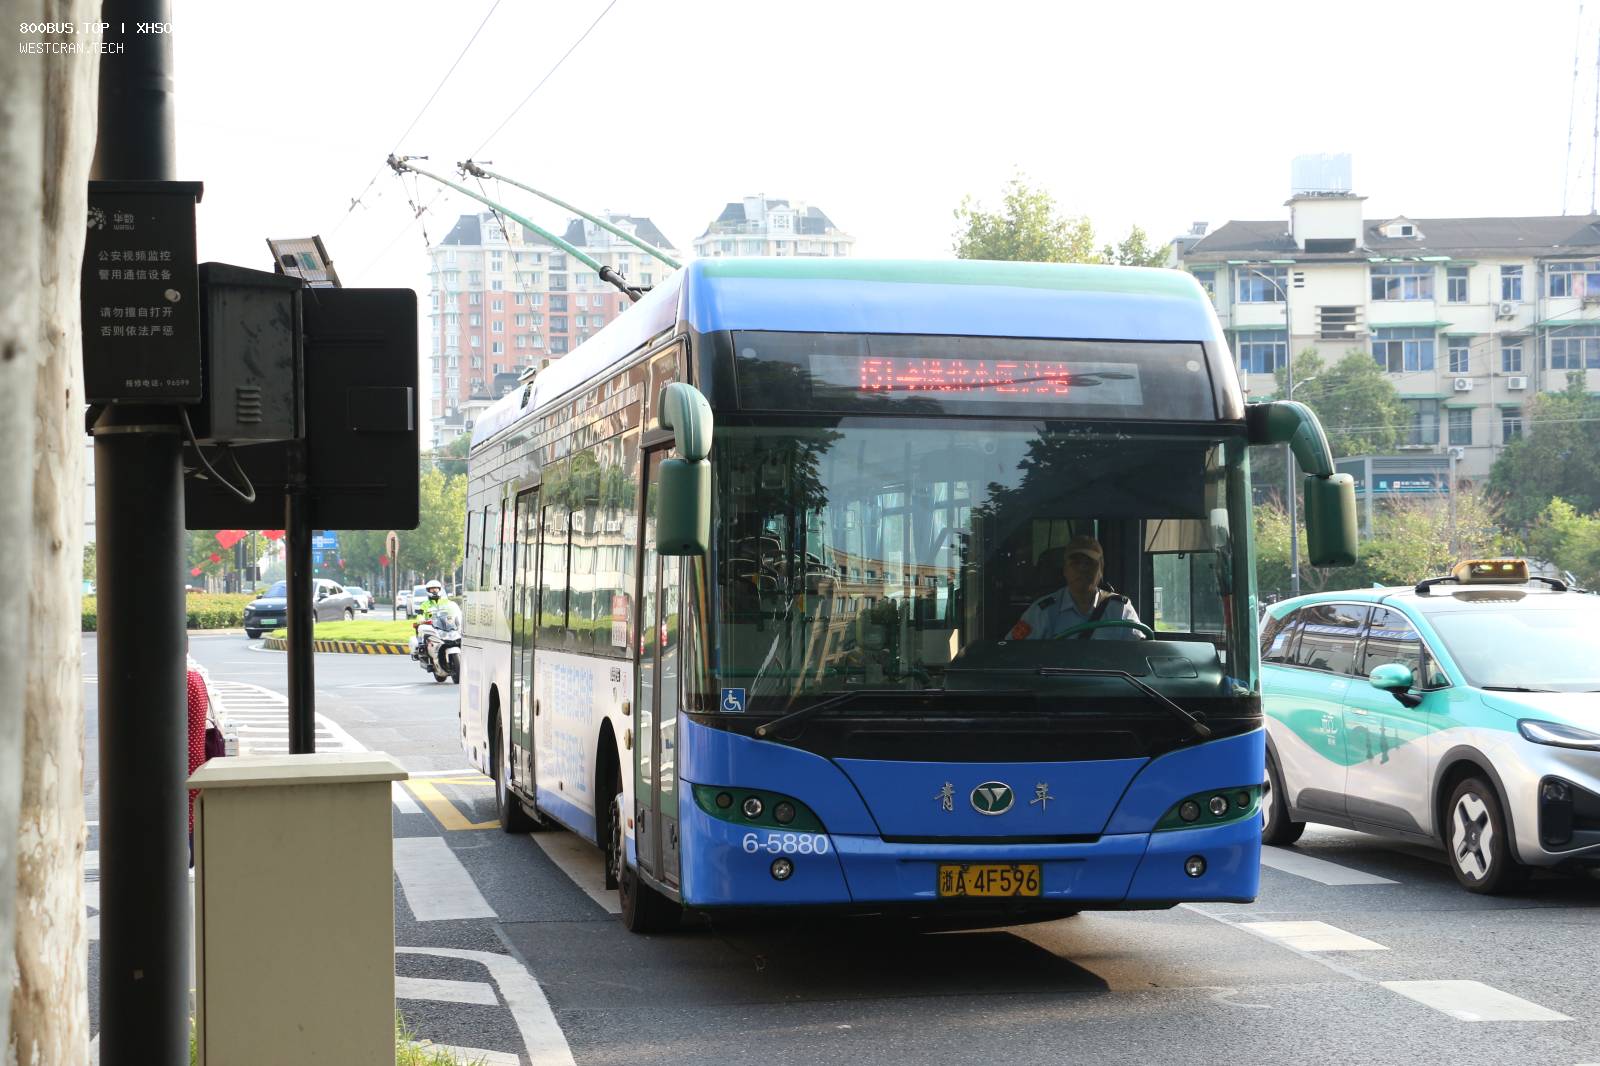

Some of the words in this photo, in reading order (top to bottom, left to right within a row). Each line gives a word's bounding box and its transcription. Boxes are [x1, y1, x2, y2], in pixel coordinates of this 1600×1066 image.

[113, 212, 134, 224] 华数
[98, 250, 172, 262] 公安视频监控
[98, 269, 172, 281] 警用通信设备
[100, 306, 174, 318] 请勿擅自打开
[100, 325, 175, 337] 否则依法严惩
[742, 833, 829, 855] 6-5880
